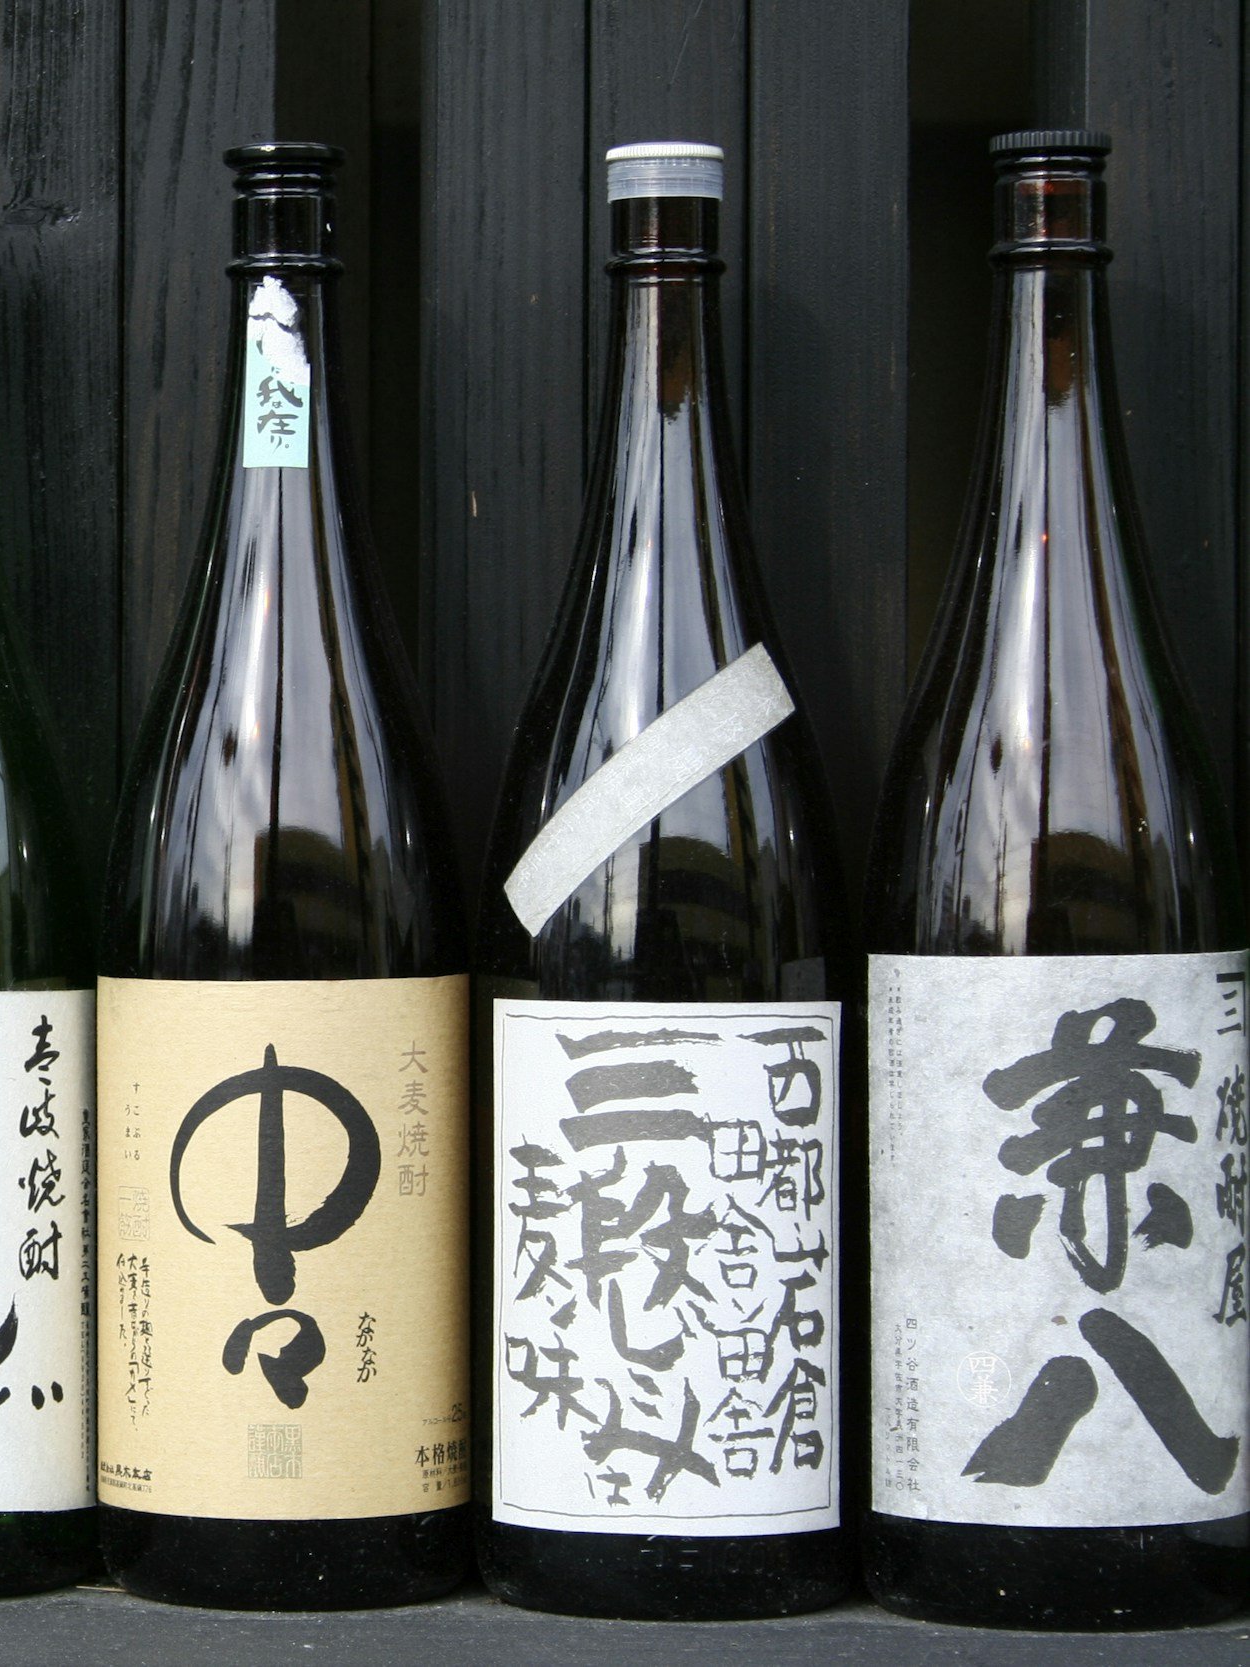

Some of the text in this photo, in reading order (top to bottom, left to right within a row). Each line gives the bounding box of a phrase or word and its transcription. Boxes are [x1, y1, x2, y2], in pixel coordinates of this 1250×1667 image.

[397, 1040, 431, 1198] 大麦焼酎
[170, 1042, 382, 1410] 中々
[960, 997, 1240, 1496] 兼八
[355, 1311, 379, 1384] なかなか
[906, 1318, 920, 1492] 四ツ谷酒造有限会社
